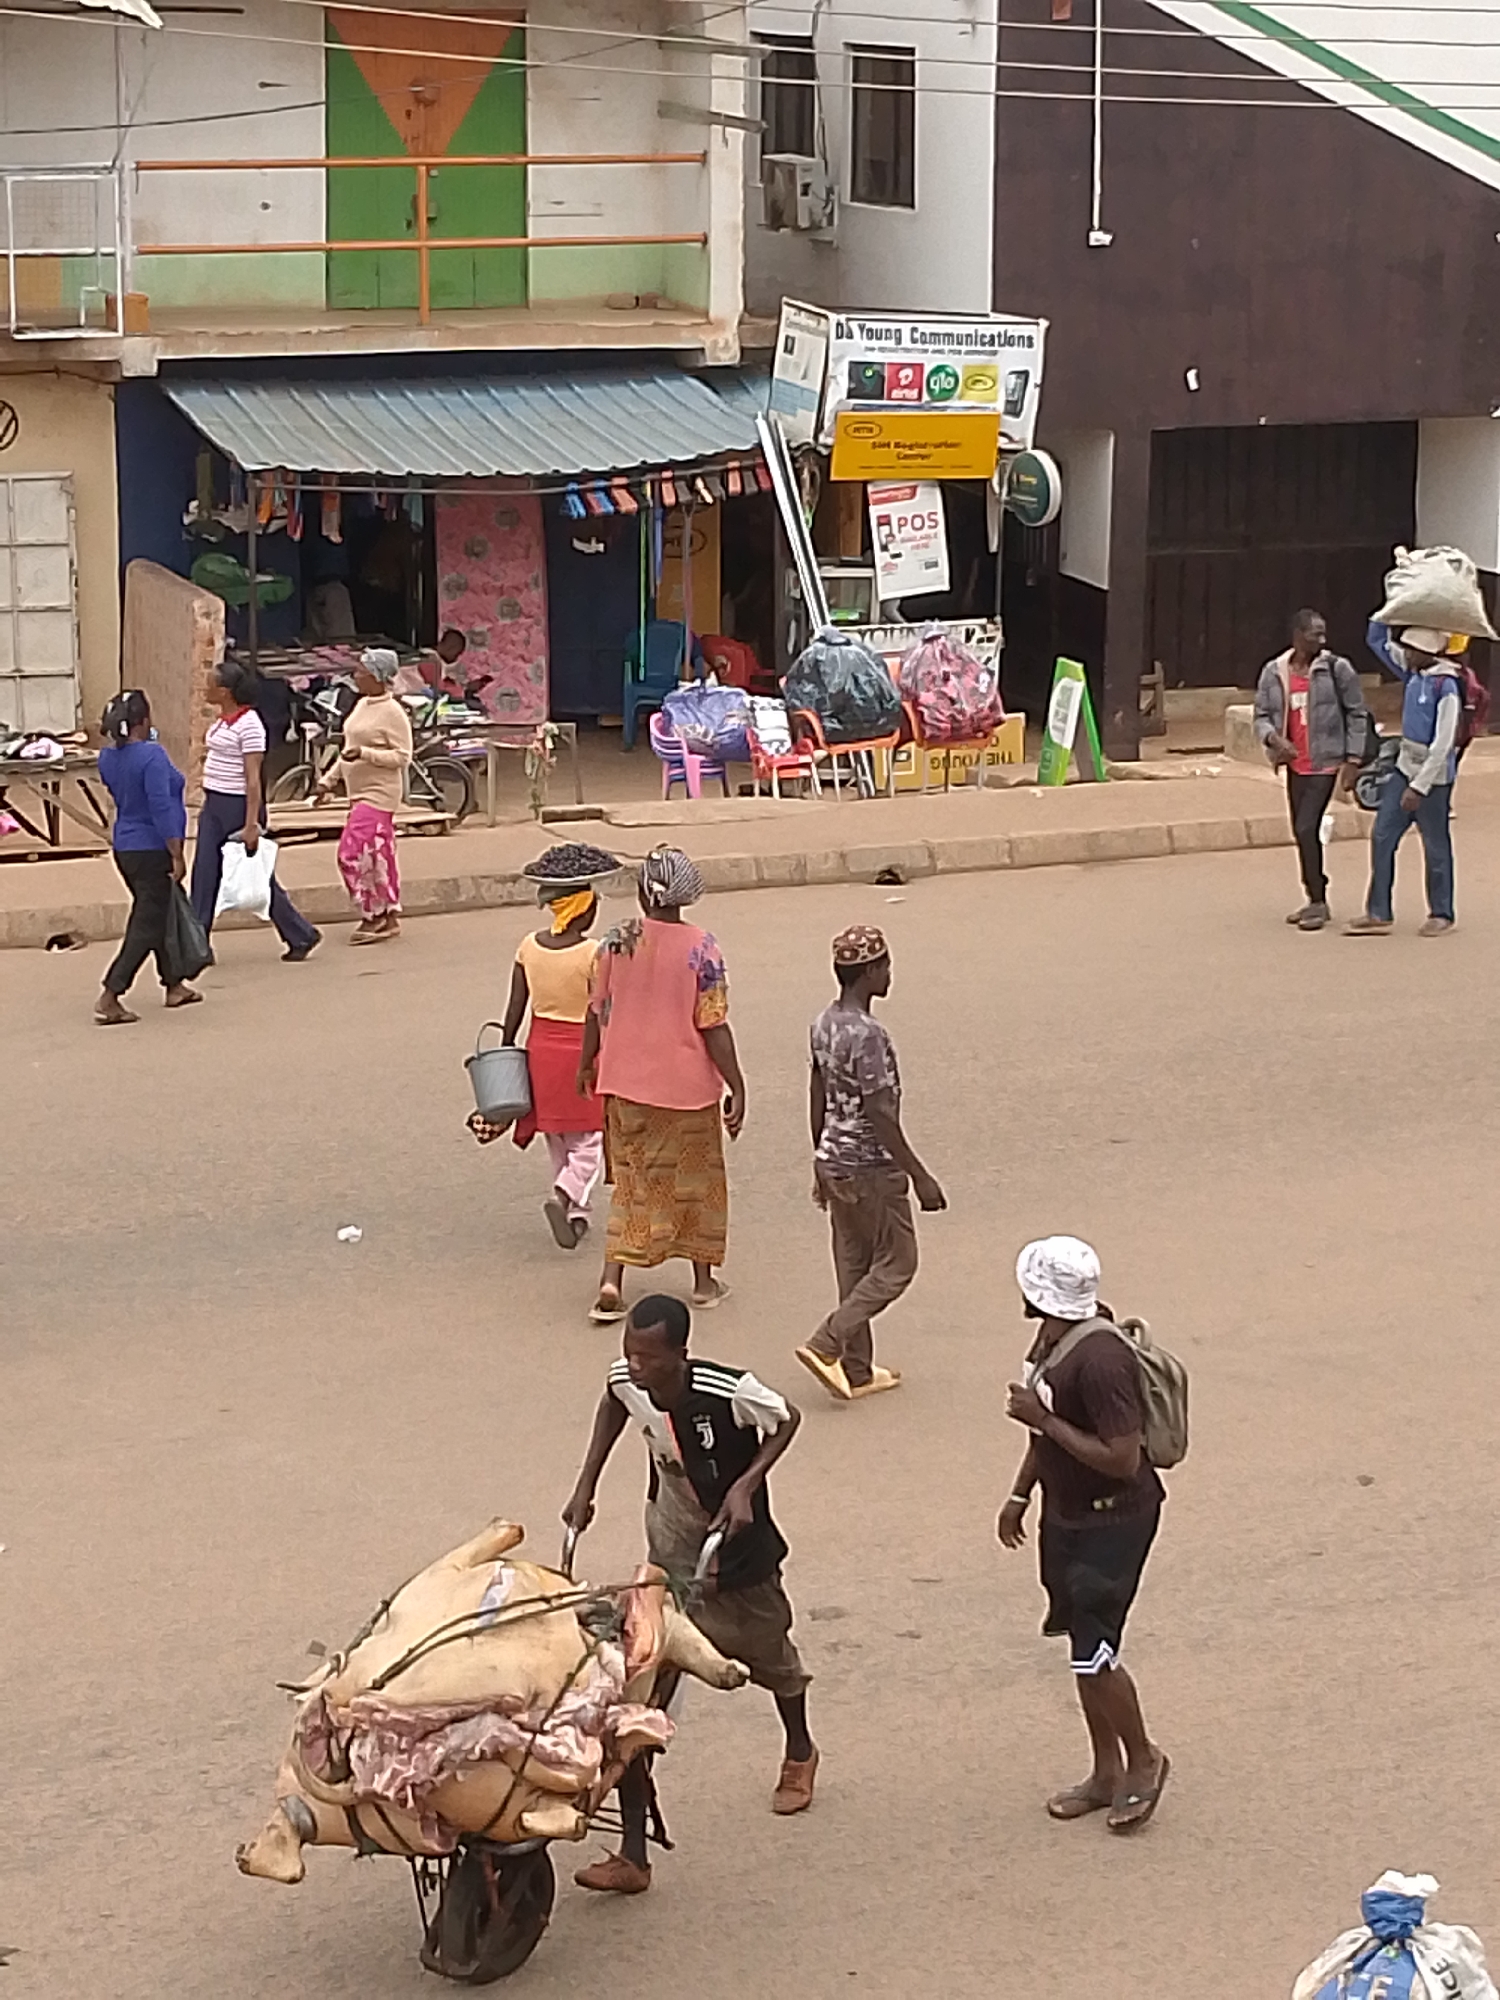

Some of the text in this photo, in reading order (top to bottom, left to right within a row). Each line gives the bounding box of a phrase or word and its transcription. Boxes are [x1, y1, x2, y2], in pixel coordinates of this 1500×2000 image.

[858, 323, 902, 345] Young
[910, 326, 1035, 349] Communications
[929, 373, 955, 394] glo
[897, 511, 939, 534] POS
